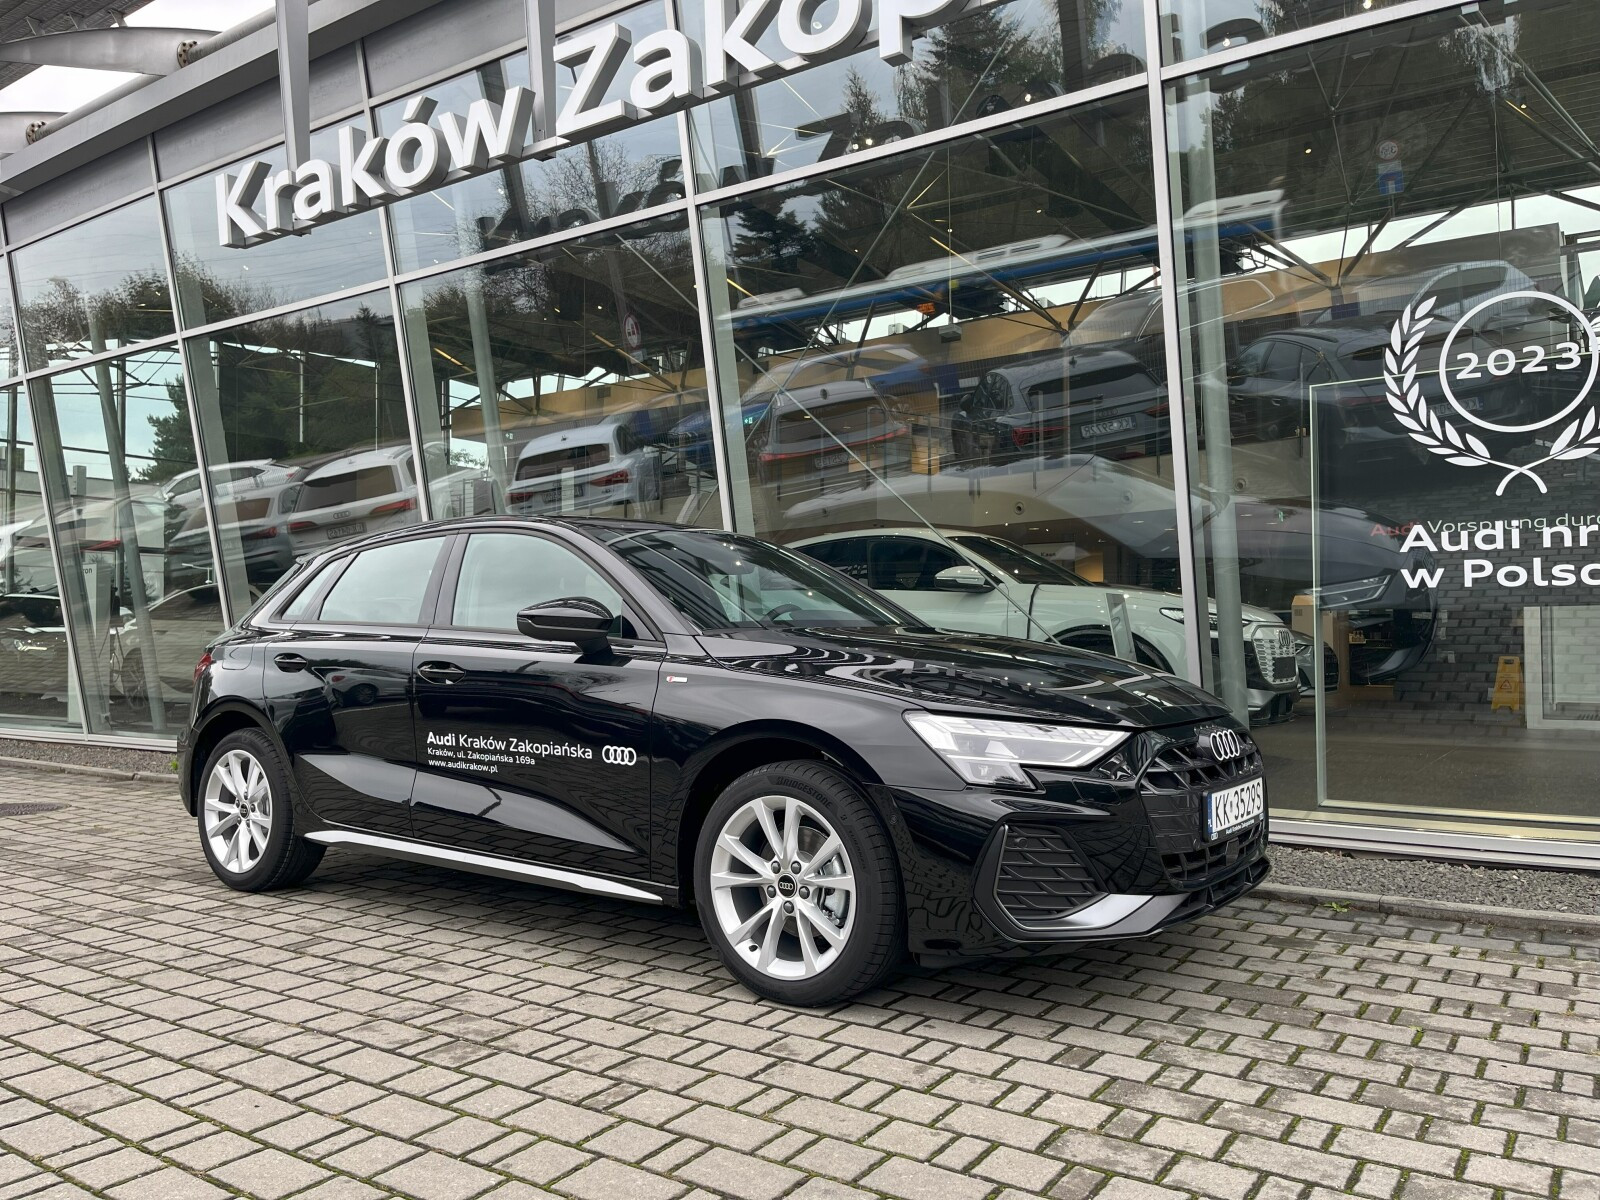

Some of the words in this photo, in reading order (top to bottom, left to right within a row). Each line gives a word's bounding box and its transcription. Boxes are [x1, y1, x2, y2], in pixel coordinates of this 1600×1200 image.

[215, 86, 534, 248] Kraków
[1455, 341, 1582, 380] 2023
[1370, 519, 1421, 538] Aud
[1427, 516, 1548, 535] Vorspung
[1555, 512, 1600, 528] dur
[1399, 519, 1520, 553] Audi
[1542, 524, 1600, 548] nr
[1400, 567, 1445, 589] w
[1463, 556, 1600, 588] Polsc
[426, 731, 456, 746] Audi
[458, 734, 507, 751] Kraków
[508, 737, 593, 759] Zakopiańska
[427, 747, 456, 758] Kraków,
[467, 750, 514, 763] Zakopiańska
[515, 755, 536, 765] 169a
[428, 759, 499, 774] www.audikrakow.pl
[775, 775, 834, 809] BRIDGESTONE
[1215, 792, 1231, 829] KK
[1234, 781, 1262, 821] 3529S
